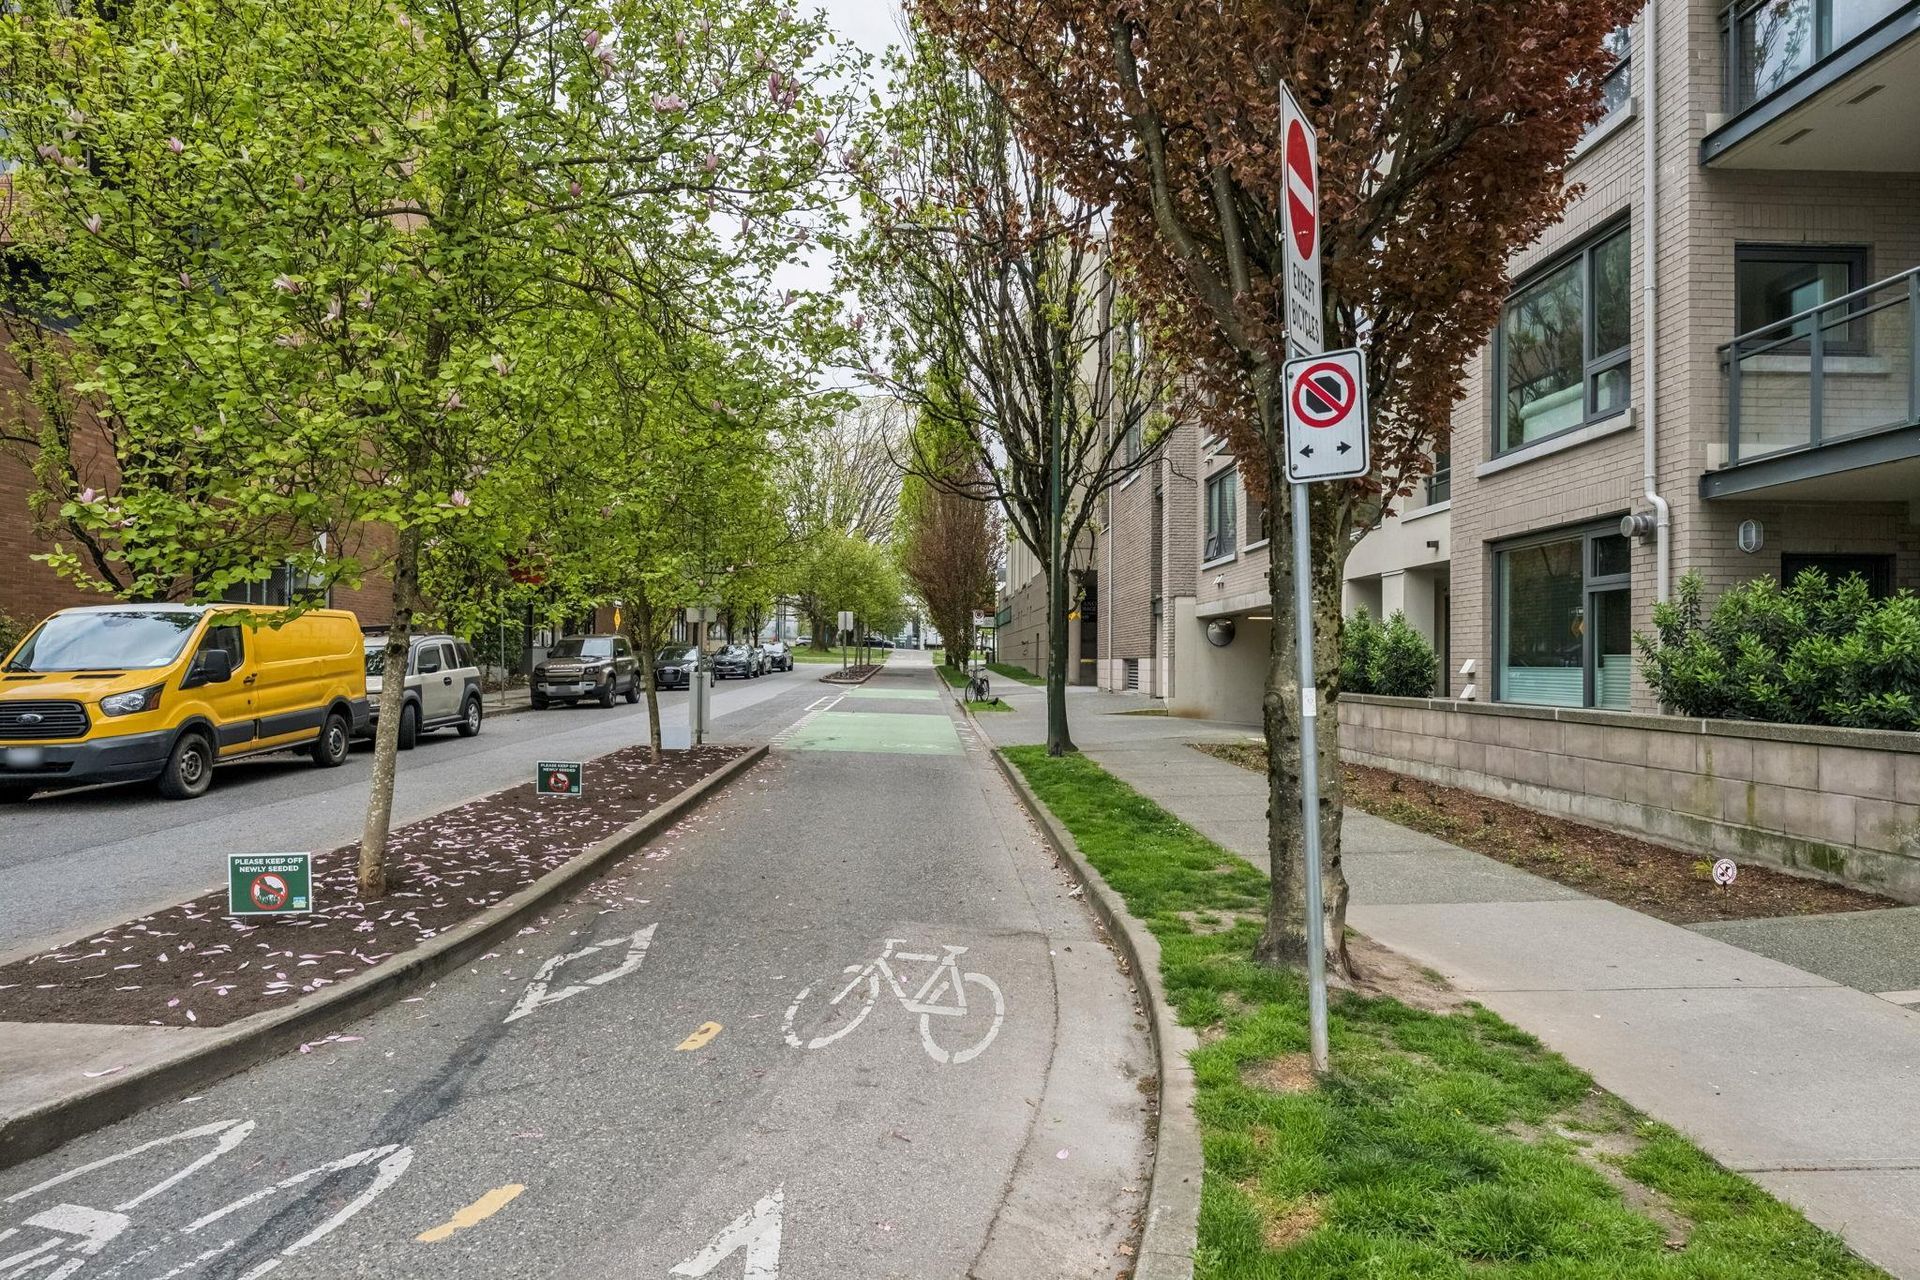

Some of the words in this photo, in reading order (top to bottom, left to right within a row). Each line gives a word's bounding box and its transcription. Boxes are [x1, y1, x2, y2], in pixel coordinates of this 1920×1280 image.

[1293, 262, 1315, 306] EXCEPT
[1292, 298, 1319, 344] BICYCLES
[234, 858, 264, 866] PLEASE
[265, 857, 286, 865] KEEP
[239, 865, 266, 873] NEWLY
